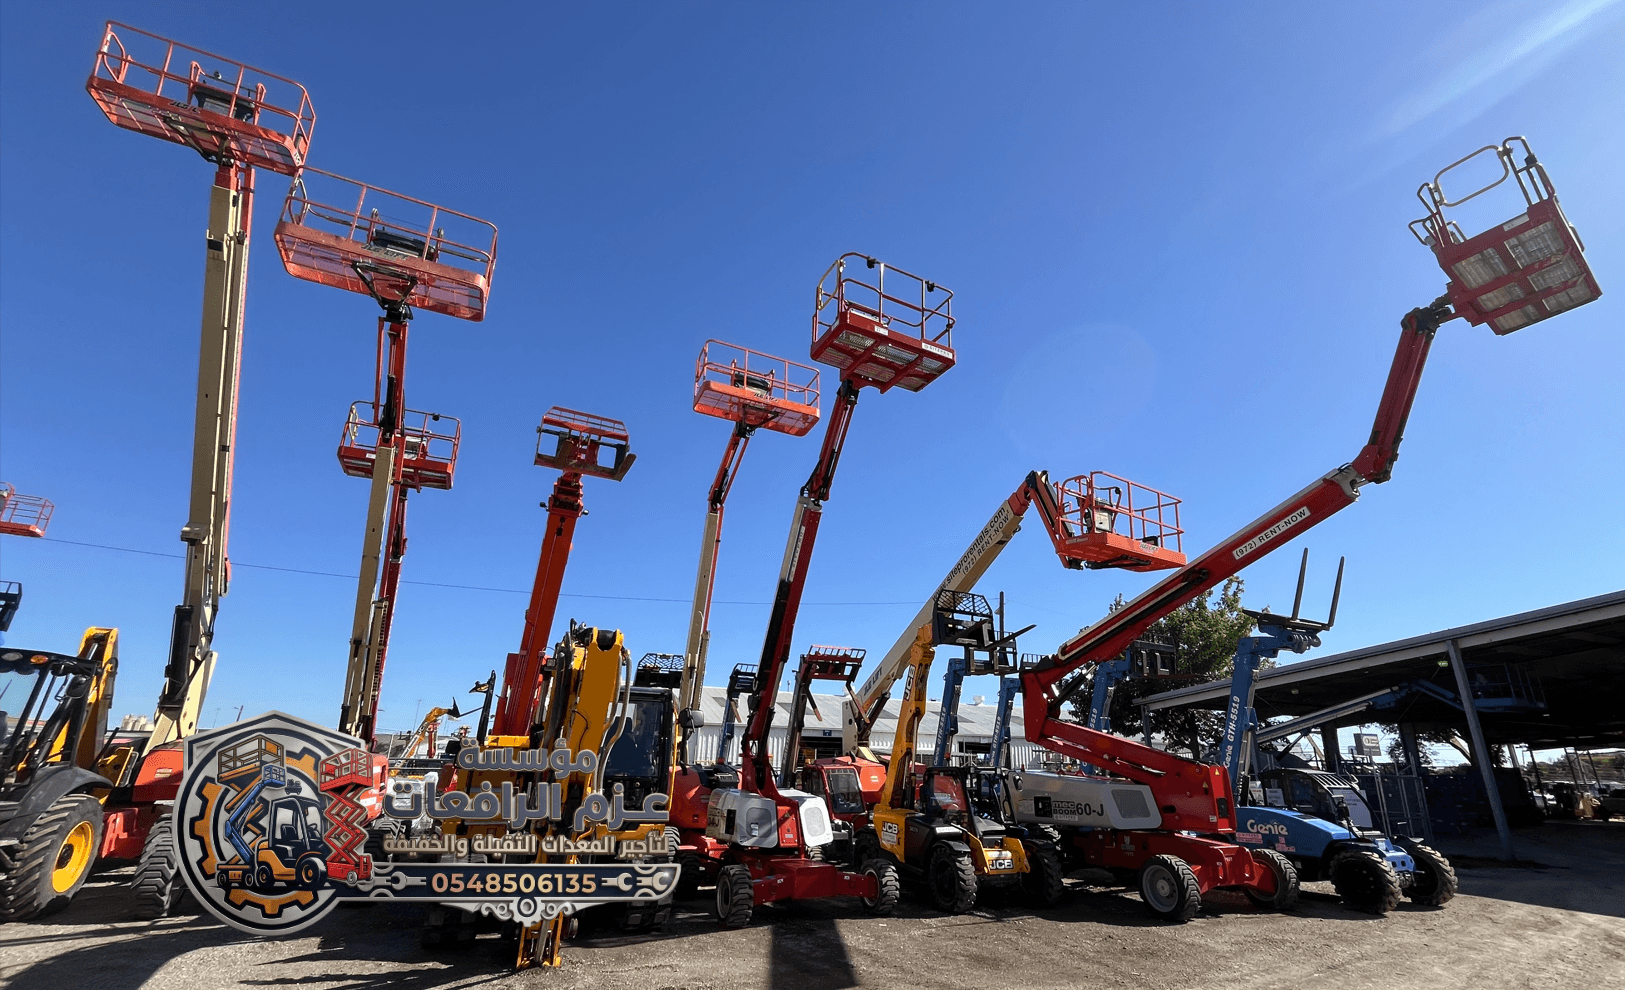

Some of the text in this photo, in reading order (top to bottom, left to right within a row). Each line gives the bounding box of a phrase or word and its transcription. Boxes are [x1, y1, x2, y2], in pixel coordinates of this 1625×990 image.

[1235, 509, 1307, 558] (972) RENT-NOW
[904, 664, 916, 701] JCB
[1227, 695, 1240, 742] GTH-5519
[1052, 801, 1075, 809] mec
[1053, 808, 1076, 816] BOOM
[1076, 803, 1104, 816] 60-J
[882, 821, 899, 835] JCB
[1247, 819, 1289, 836] Genie
[989, 859, 1014, 870] JCB
